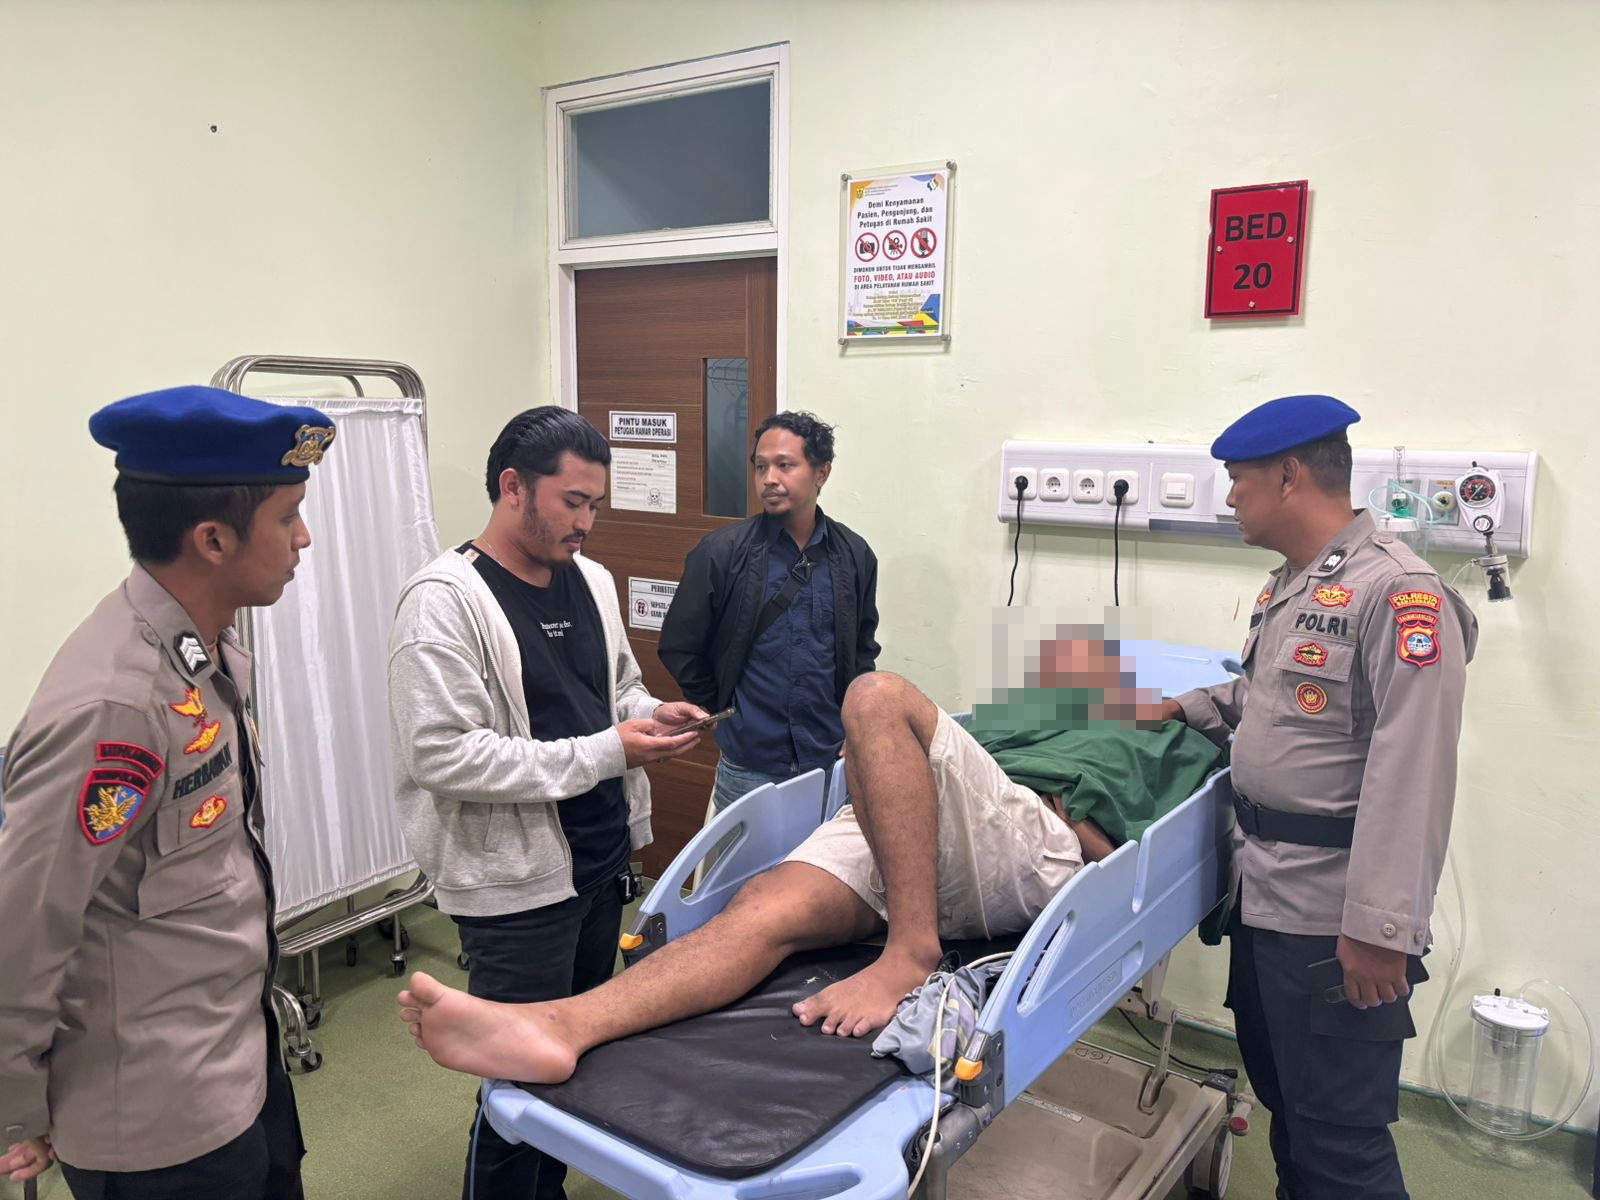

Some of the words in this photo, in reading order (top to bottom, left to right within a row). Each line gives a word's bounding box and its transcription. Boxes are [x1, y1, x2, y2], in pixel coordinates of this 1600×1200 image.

[868, 200, 883, 209] Demi
[885, 198, 924, 208] Kenyamanan
[857, 211, 880, 220] Pasien,
[881, 208, 919, 218] Pengunjung,
[859, 219, 884, 229] Petugas
[885, 218, 892, 226] di
[893, 217, 915, 225] Rumah
[916, 215, 933, 223] Sakit
[1225, 212, 1287, 242] BED
[853, 266, 875, 274] DIMOHON
[907, 262, 936, 270] MENGAMBIL
[854, 274, 872, 284] FOTO,
[897, 272, 913, 280] ATAU
[915, 270, 936, 279] AUDIO
[1233, 262, 1272, 290] 20
[901, 280, 919, 288] RUMAH
[920, 279, 934, 287] SAKIT
[618, 417, 640, 426] PINTU
[641, 418, 667, 427] MASUK
[614, 426, 635, 435] PETUGAS
[635, 427, 651, 436] KAMAR
[652, 428, 672, 437] OPERASI
[1392, 592, 1438, 604] POLRESTA
[1295, 613, 1348, 636] POLRI
